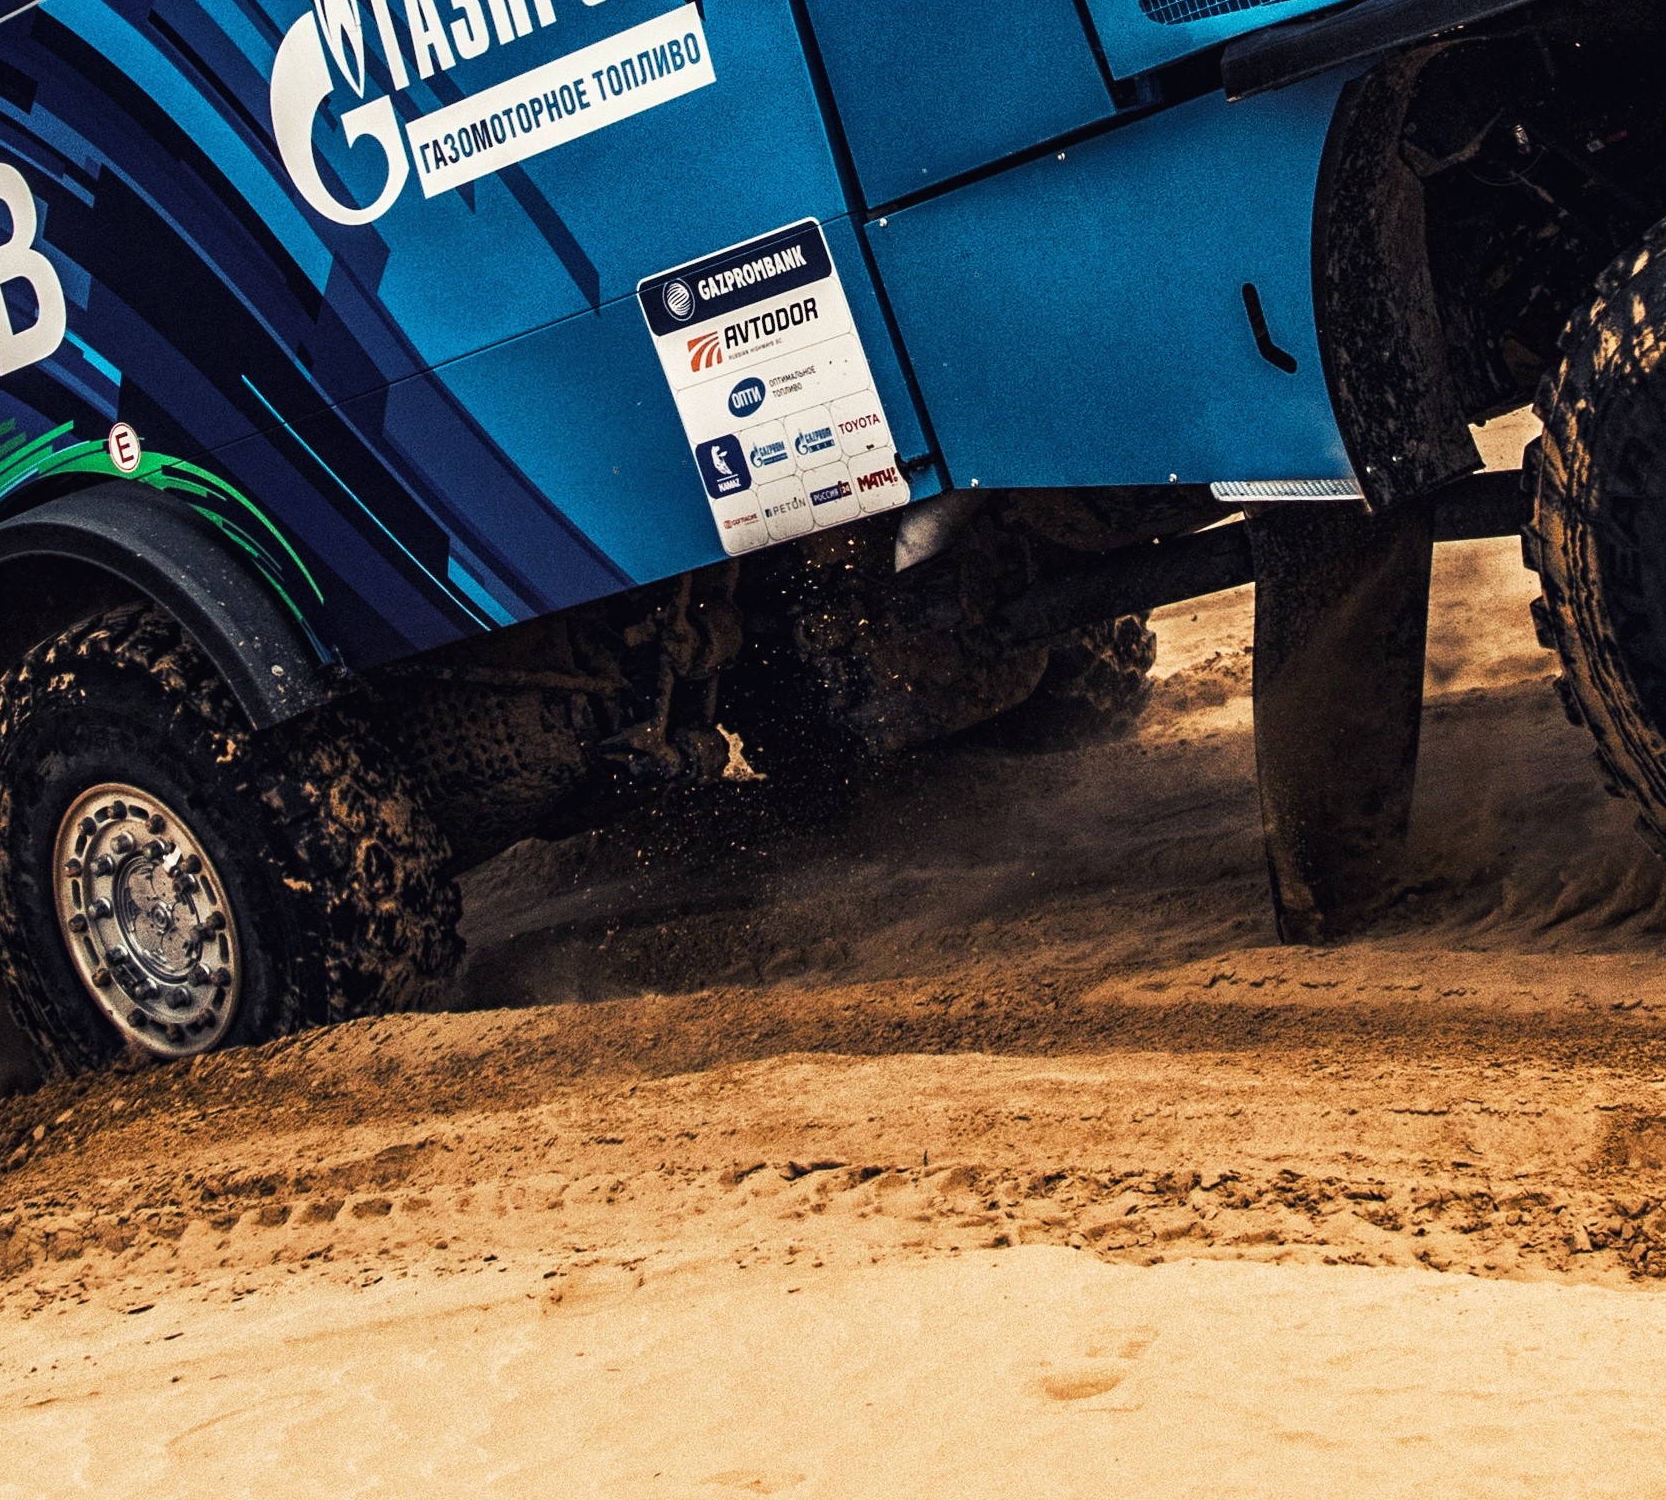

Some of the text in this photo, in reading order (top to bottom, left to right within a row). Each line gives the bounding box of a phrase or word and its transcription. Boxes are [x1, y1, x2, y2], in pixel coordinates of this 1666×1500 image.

[418, 31, 703, 174] ГАЗОМОТОРНОЕ ТОПЛИВО
[697, 244, 807, 301] GAZPROMBANK
[724, 297, 819, 350] AVTODOR
[731, 386, 763, 409] ОПТИ
[838, 413, 881, 435] TOYOTA
[115, 432, 134, 464] E
[856, 466, 898, 493] МАТЧ!
